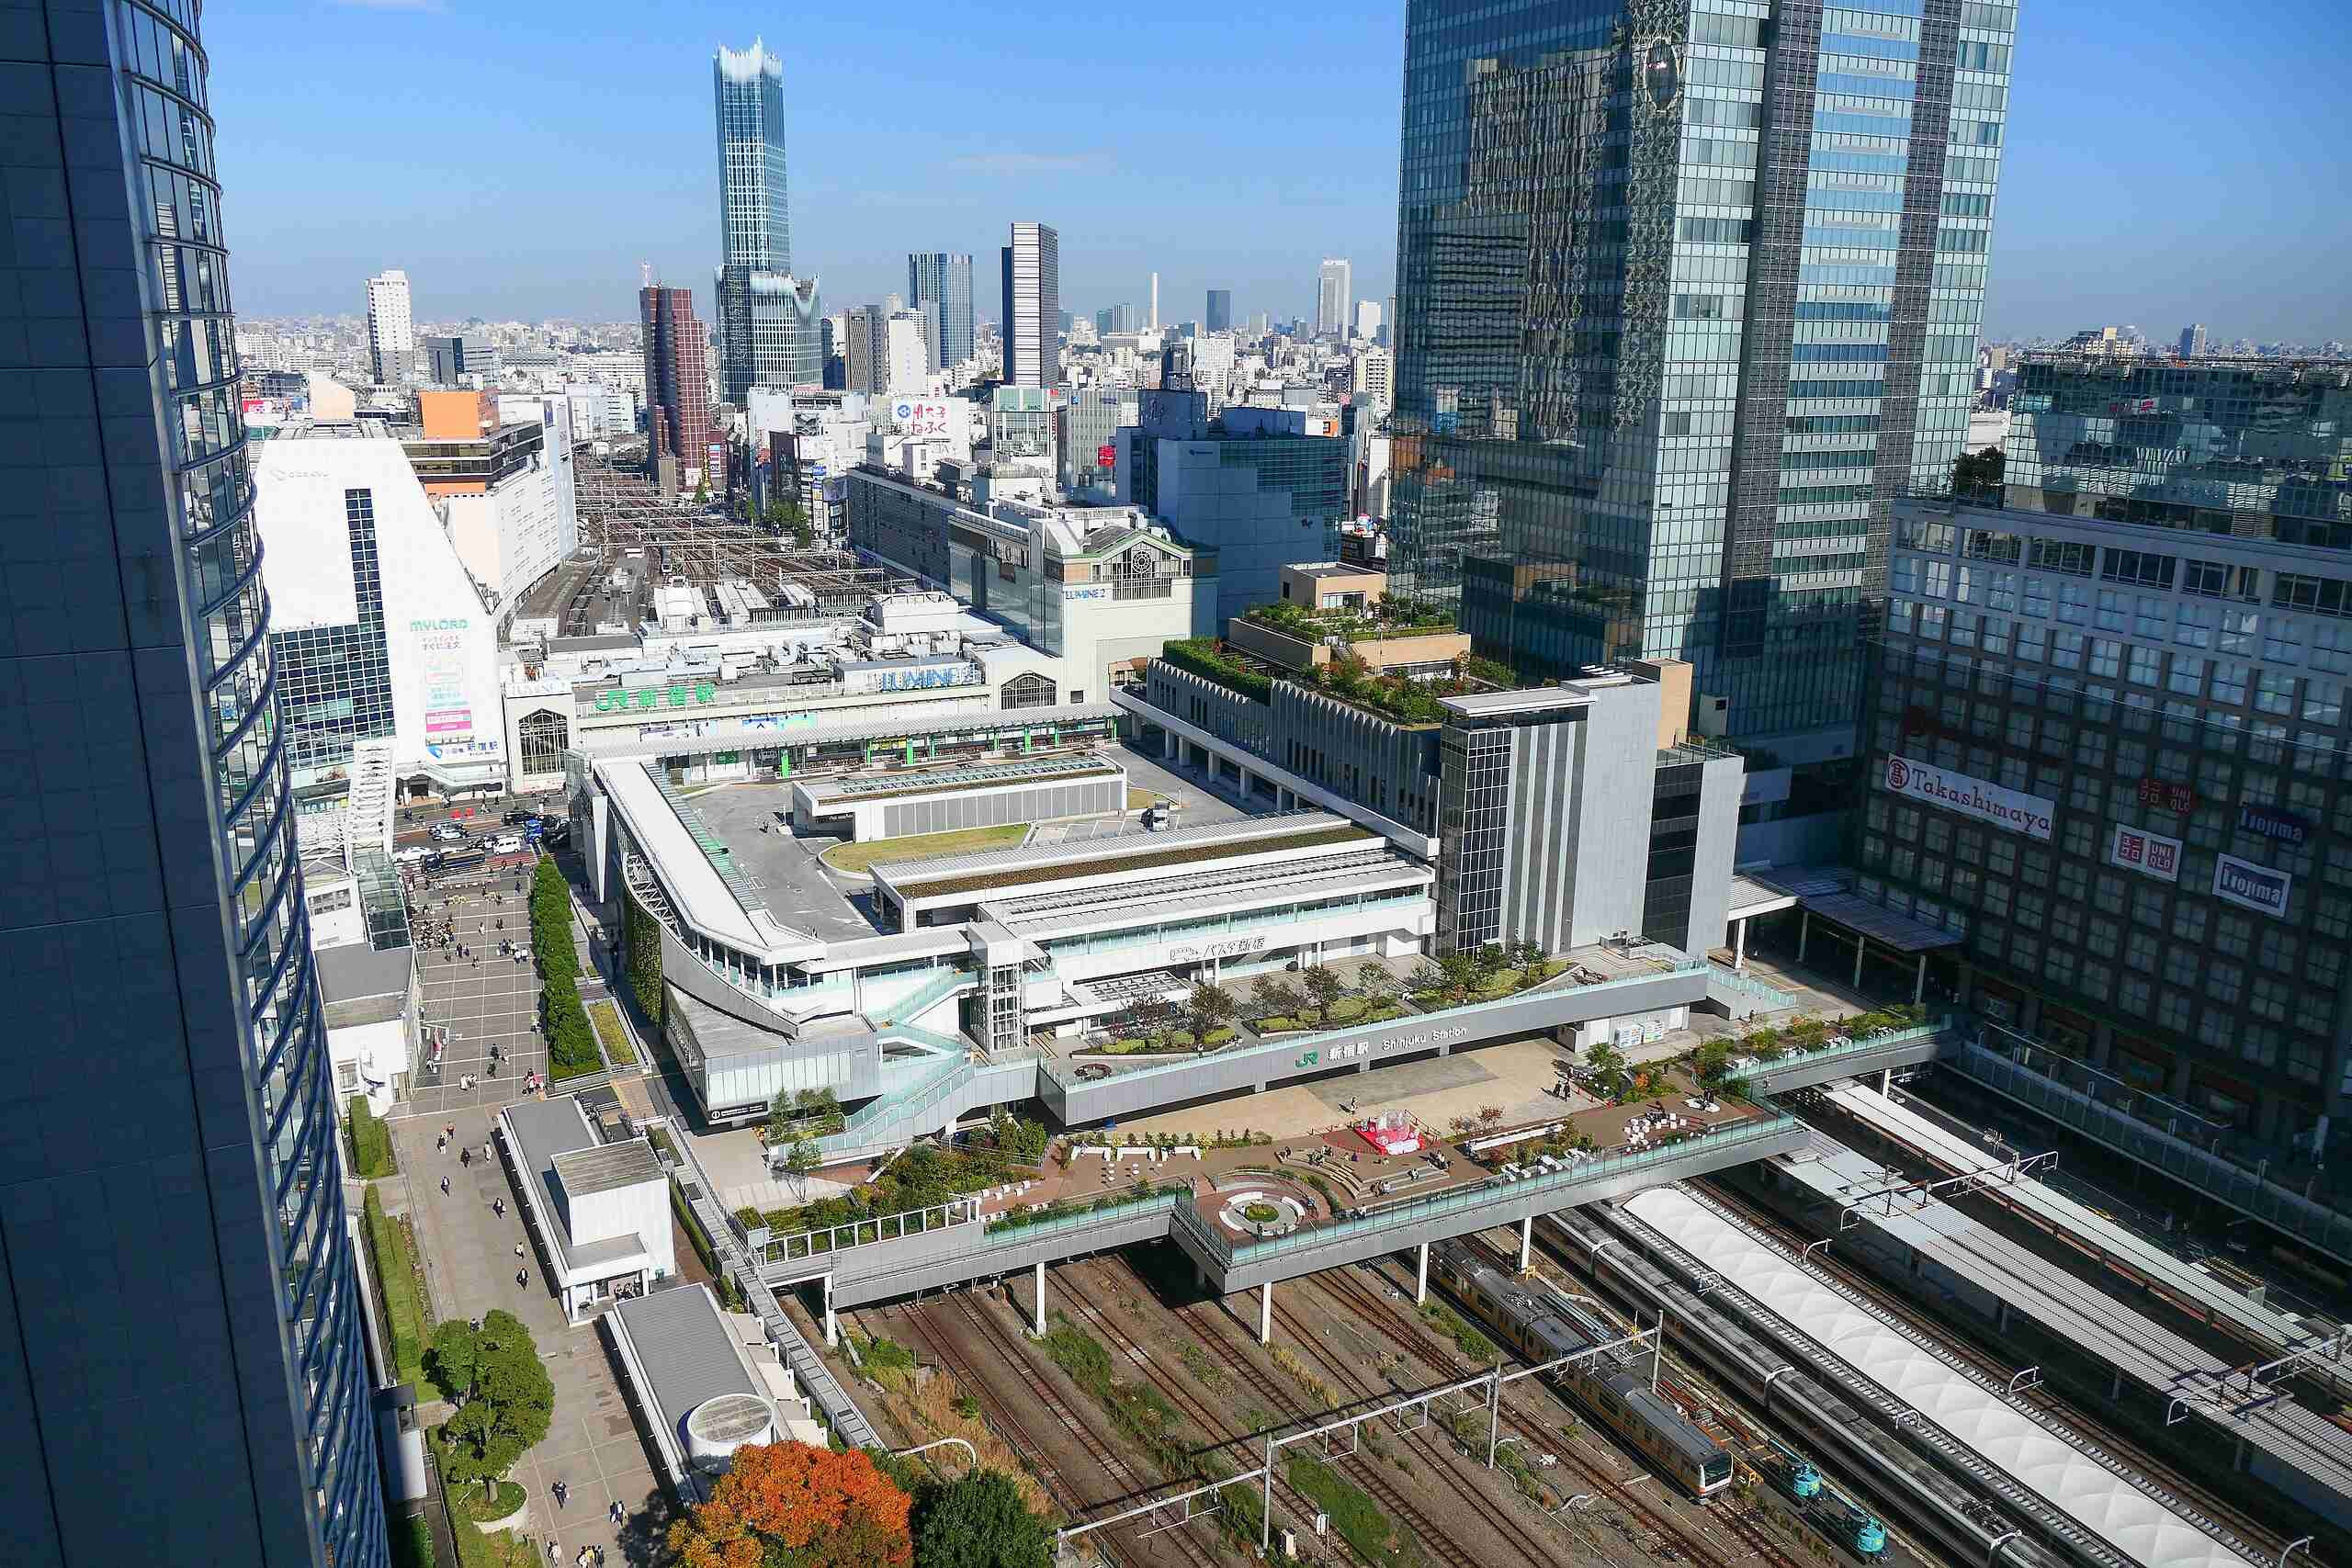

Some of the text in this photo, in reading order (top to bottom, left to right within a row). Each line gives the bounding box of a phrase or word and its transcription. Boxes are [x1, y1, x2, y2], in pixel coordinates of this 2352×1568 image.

[882, 668, 957, 690] LUMINE
[1913, 768, 2050, 831] Takashimaya
[1329, 1041, 1369, 1060] 新宿駅
[1383, 1035, 1426, 1052] Shinjuku
[1432, 1028, 1467, 1042] Station
